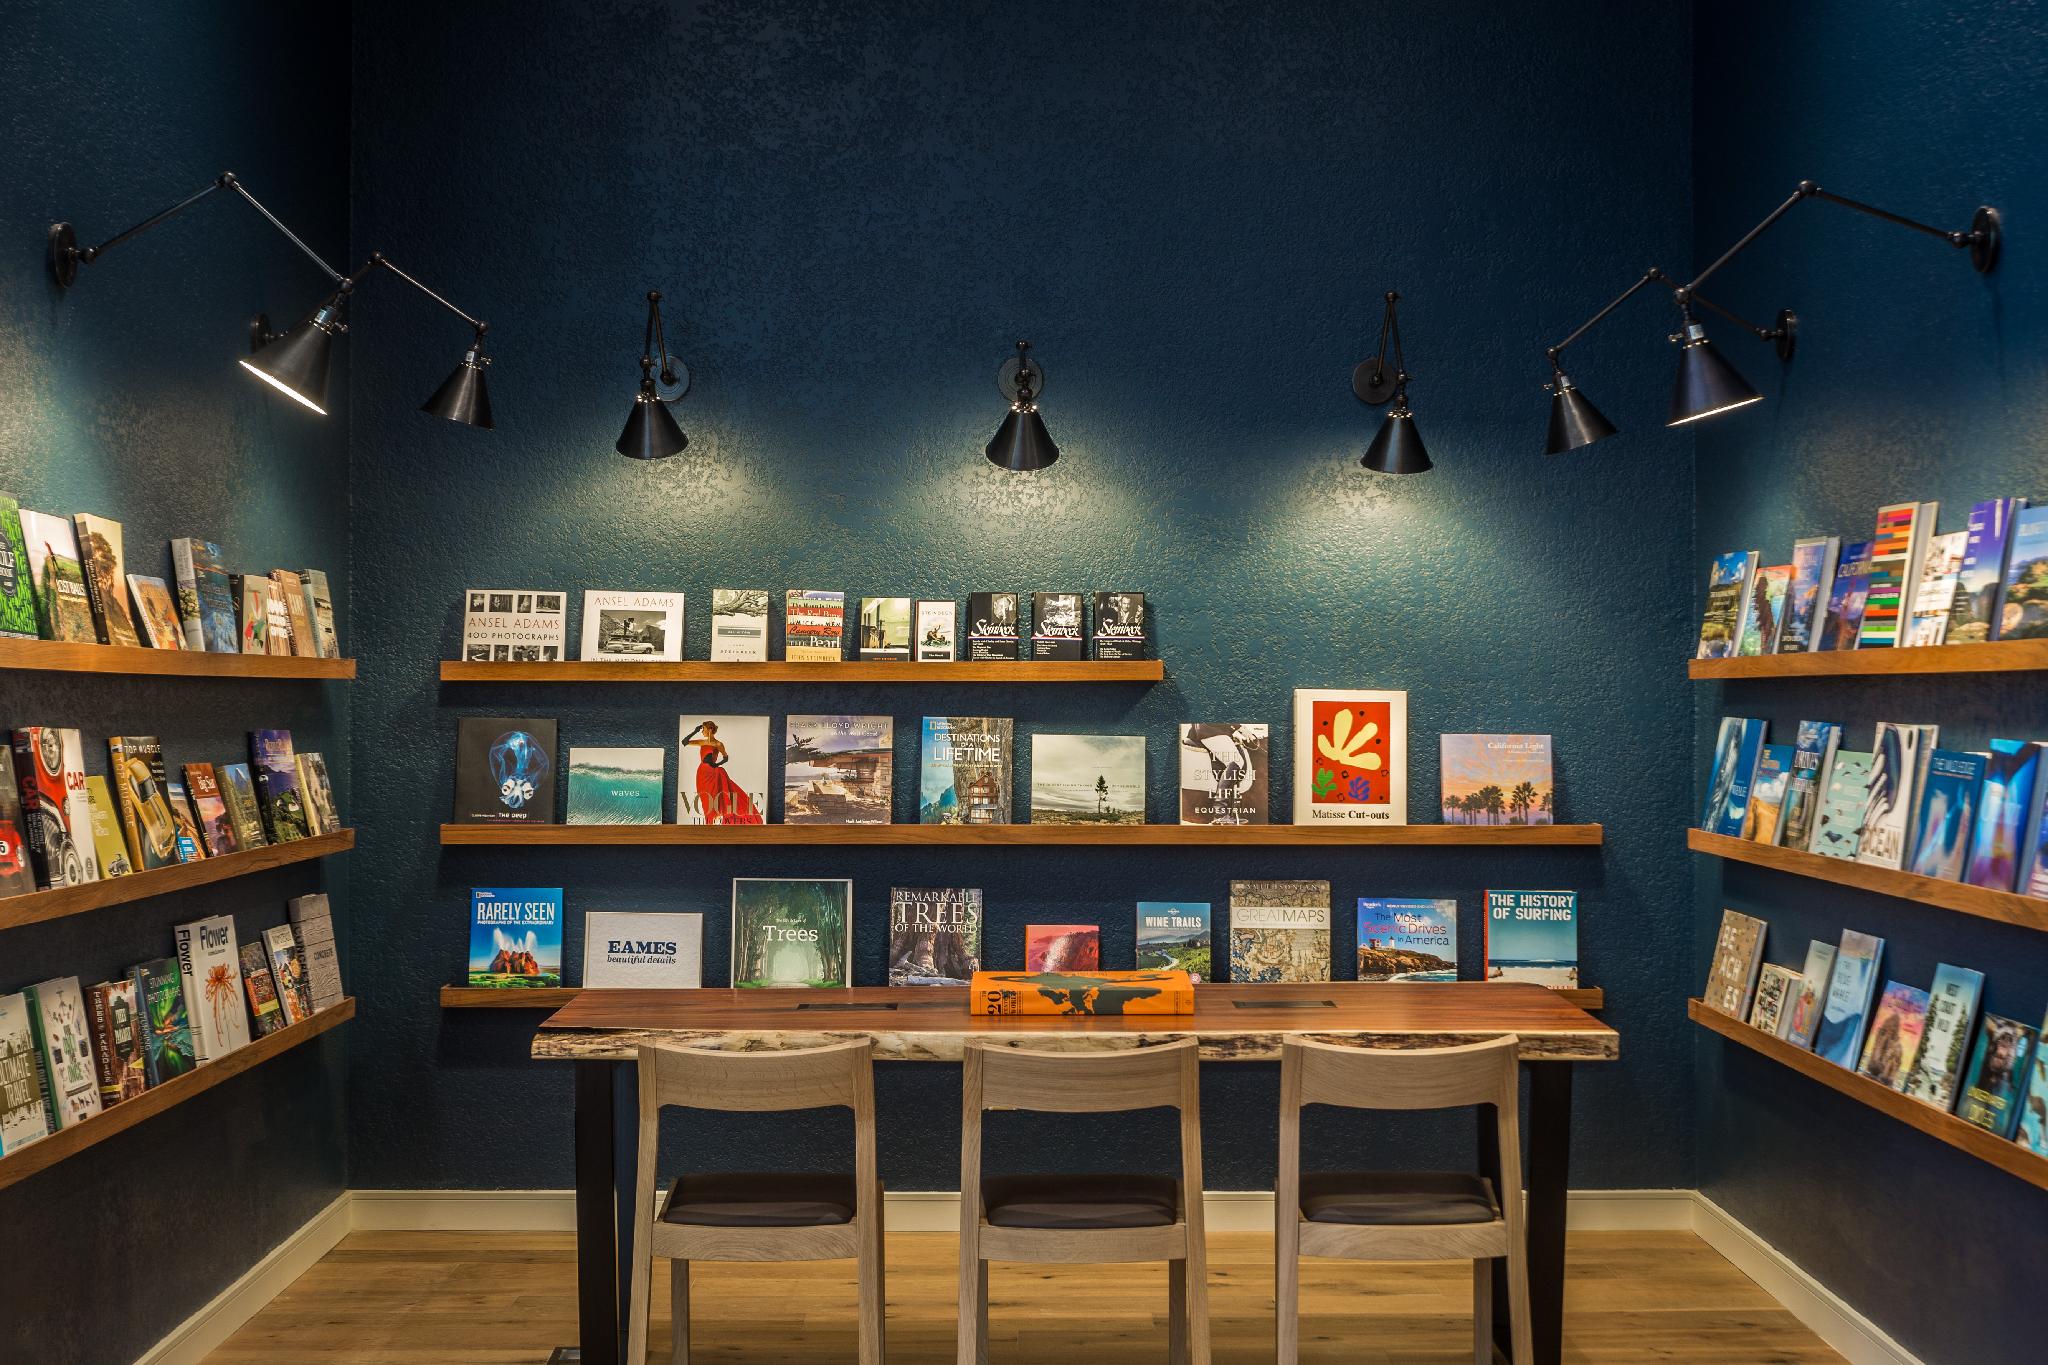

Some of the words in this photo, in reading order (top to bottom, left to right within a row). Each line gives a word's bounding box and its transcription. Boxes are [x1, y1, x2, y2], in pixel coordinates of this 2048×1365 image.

[595, 596, 628, 606] ANSEL
[634, 598, 674, 607] ADAMS
[469, 617, 507, 628] ANSEL
[514, 618, 560, 629] ADAMS
[491, 632, 559, 640] PHOTOGRAPHS
[810, 635, 840, 648] Pearl
[934, 733, 1001, 743] DESTINATIONS
[123, 745, 137, 754] TOP
[1488, 742, 1523, 750] California
[1525, 742, 1544, 751] Light
[934, 747, 1001, 761] LIFETIME
[117, 757, 125, 779] TOP
[1194, 769, 1257, 780] STYLISH
[67, 772, 86, 790] CAR
[22, 776, 42, 812] CAR
[611, 789, 640, 797] waves
[1208, 788, 1243, 799] LIFE
[120, 782, 135, 828] MUSCLE
[680, 792, 764, 815] VOGUE
[1312, 809, 1346, 819] Matisse
[1348, 810, 1390, 820] Cut-outs
[896, 891, 978, 902] REMARKABLE
[1490, 893, 1516, 907] THE
[1520, 894, 1575, 908] HISTORY
[477, 902, 521, 920] RARELY
[524, 902, 555, 920] SEEN
[894, 901, 979, 925] TREES
[1375, 913, 1391, 921] The
[1394, 912, 1422, 922] Most
[1493, 907, 1511, 919] OF
[1515, 908, 1572, 921] SURFING
[1145, 916, 1169, 928] WINE
[1171, 916, 1202, 928] TRAILS
[1363, 921, 1406, 934] Scenic
[1408, 923, 1447, 935] Drives
[763, 925, 818, 942] Trees
[894, 923, 909, 933] OF
[912, 923, 934, 933] THE
[936, 924, 978, 934] WORLD
[200, 925, 228, 950] Flower
[1405, 935, 1449, 946] America
[177, 930, 193, 977] Flower
[608, 940, 677, 955] EAMES
[607, 955, 646, 964] beautiful
[647, 956, 677, 964] details
